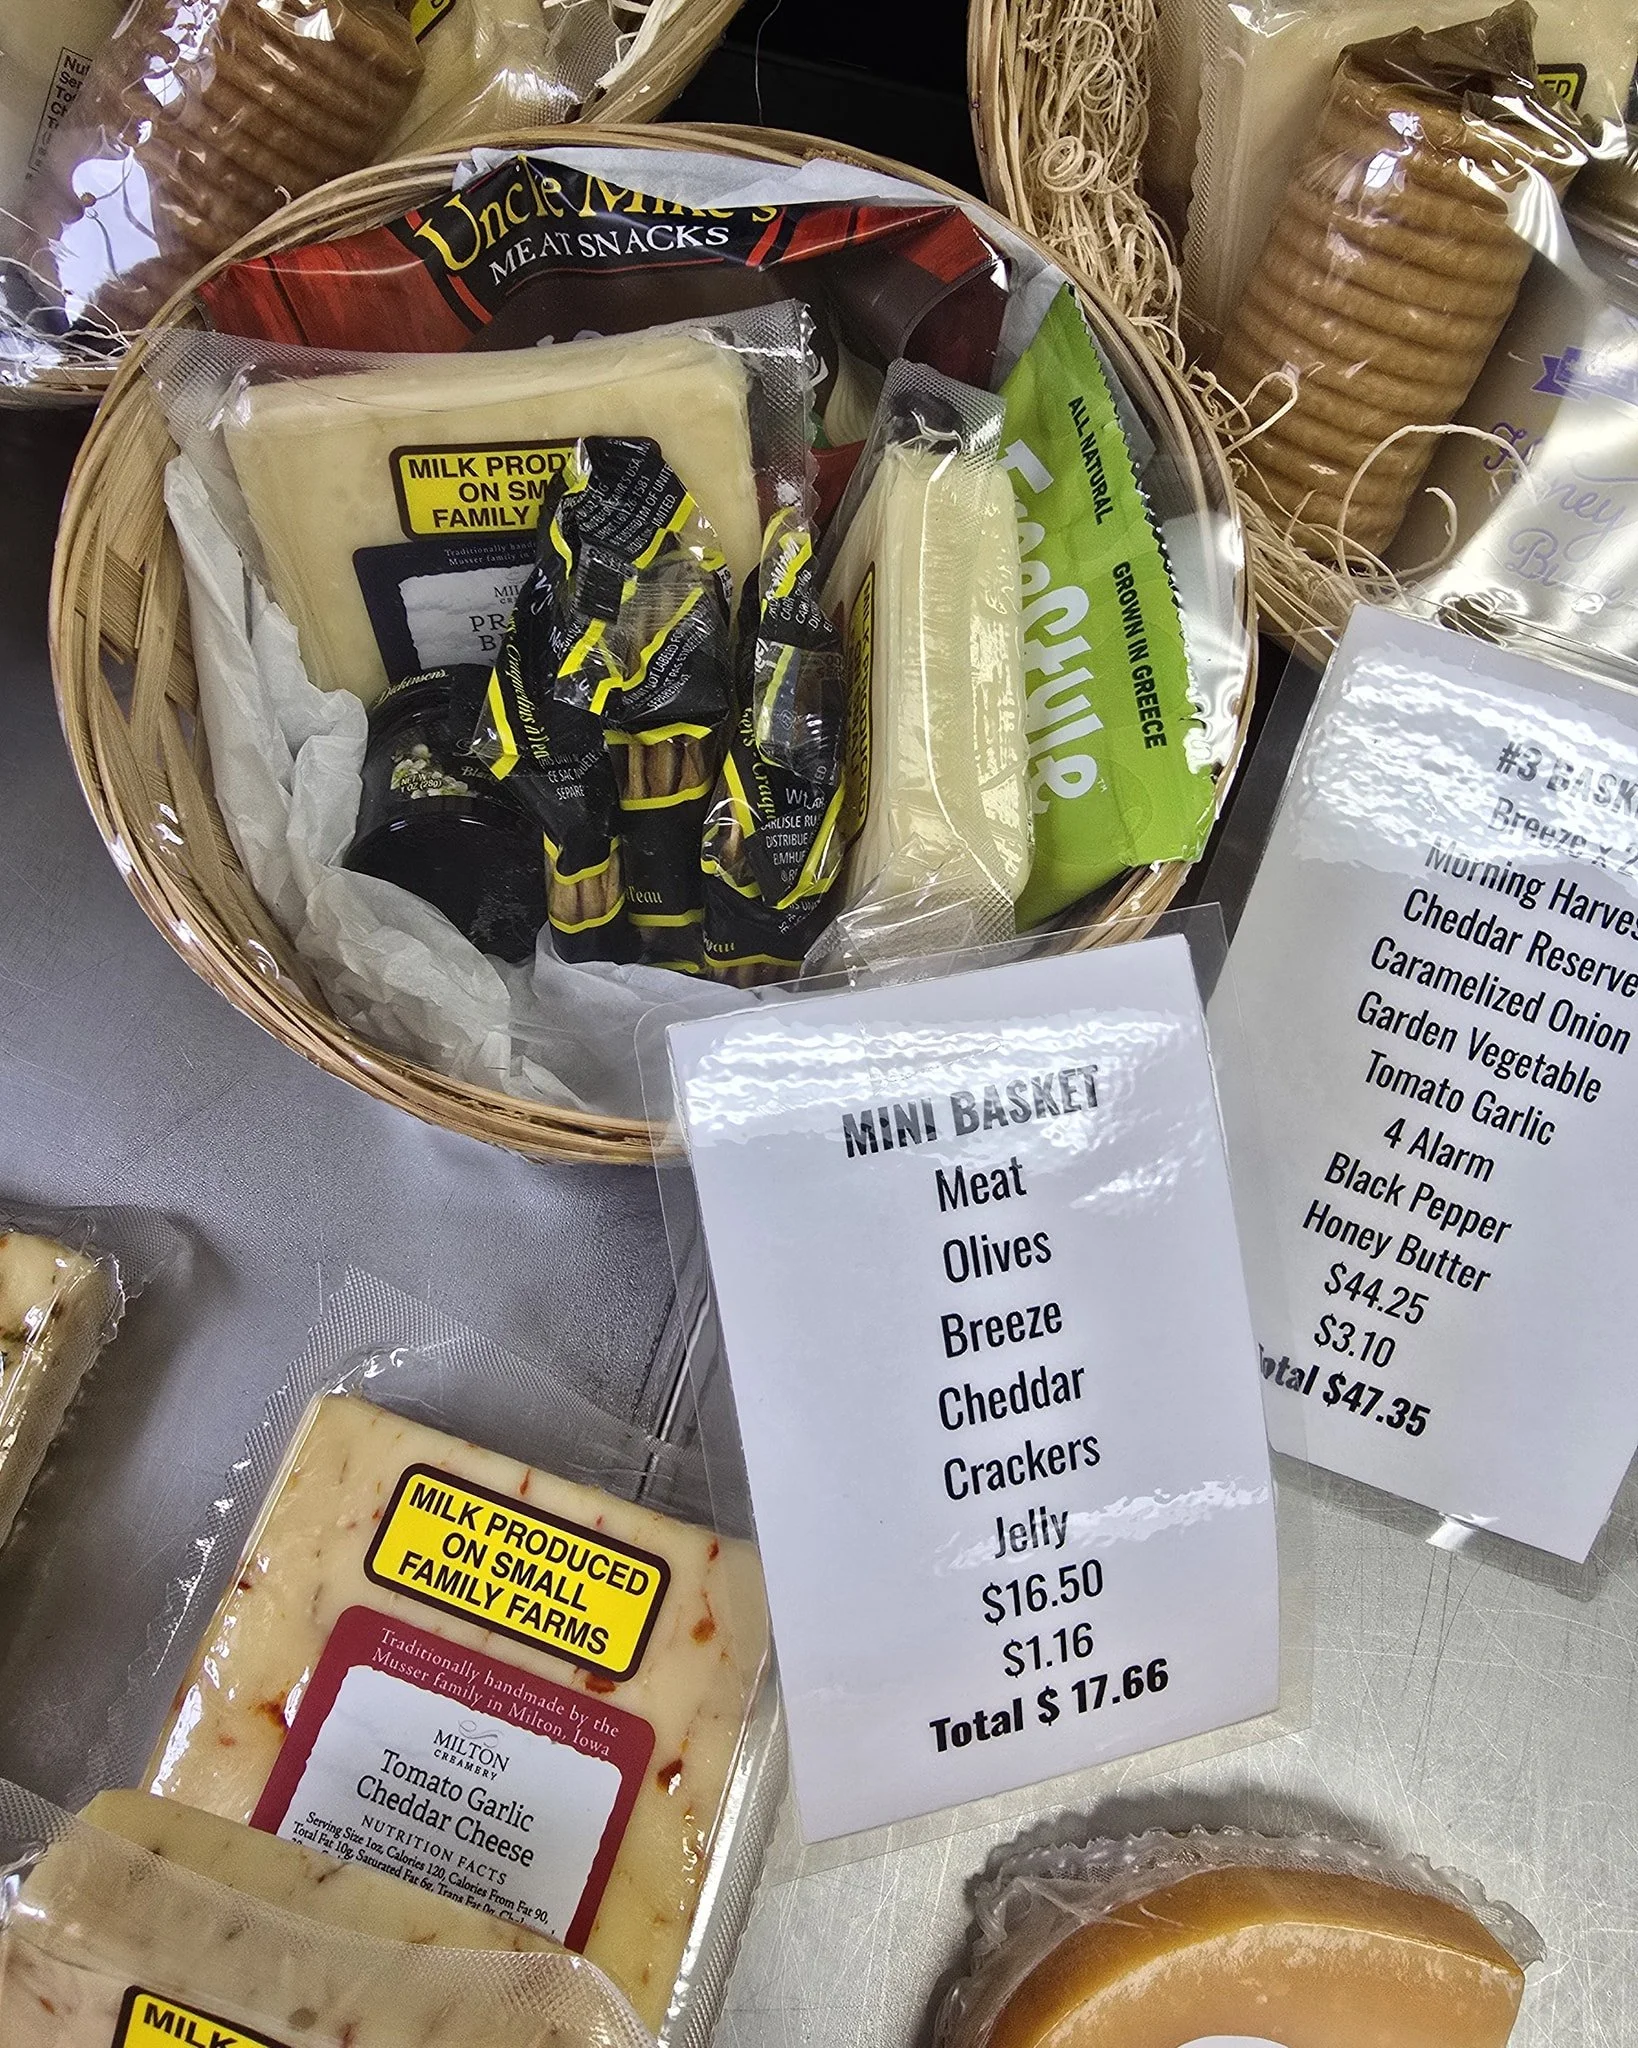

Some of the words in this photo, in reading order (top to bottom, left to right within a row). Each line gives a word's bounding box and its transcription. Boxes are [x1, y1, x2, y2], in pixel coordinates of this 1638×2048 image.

[415, 156, 563, 271] Uncle
[488, 231, 574, 286] MEAT
[580, 224, 729, 259] SNACKS
[408, 457, 485, 479] MILK
[486, 452, 572, 477] PROD
[459, 482, 499, 503] ON
[1068, 396, 1088, 438] ALL
[1079, 433, 1115, 526] NATURAL
[432, 506, 530, 528] FAMILY
[652, 494, 678, 527] IMITED.
[1111, 561, 1145, 641] GROWN
[1126, 635, 1149, 664] IN
[1132, 656, 1167, 750] GREECE
[1496, 741, 1543, 782] #3
[1546, 757, 1638, 820] BASK
[1488, 796, 1588, 859] Breeze
[1424, 834, 1547, 910] Morning
[1403, 888, 1523, 956] Cheddar
[1525, 930, 1638, 999] Reserve
[1371, 936, 1547, 1024] Caramelized
[1548, 999, 1632, 1056] Onion
[1357, 991, 1459, 1053] Garden
[1467, 1027, 1603, 1103] Vegetable
[842, 1097, 938, 1158] MINI
[951, 1064, 1100, 1137] BASKET
[1365, 1050, 1465, 1114] Tomato
[1471, 1089, 1557, 1146] Garlic
[935, 1156, 1028, 1212] Meat
[1383, 1117, 1406, 1150] 4
[1407, 1126, 1496, 1183] Alarm
[1323, 1151, 1406, 1207] Black
[1408, 1182, 1512, 1245] Pepper
[942, 1231, 1053, 1283] Olives
[1302, 1199, 1393, 1260] Honey
[1395, 1233, 1492, 1293] Butter
[940, 1301, 1064, 1358] Breeze
[1323, 1261, 1430, 1325] $44.25
[1314, 1312, 1396, 1369] $3.10
[938, 1365, 1086, 1431] Cheddar
[1322, 1371, 1431, 1437] $47.35
[943, 1435, 1102, 1500] Crackers
[409, 1483, 484, 1531] MILK
[485, 1512, 650, 1596] PRODUCED
[994, 1506, 1069, 1559] Jelly
[398, 1551, 504, 1610] FAMILY
[506, 1595, 610, 1655] FARMS
[442, 1533, 488, 1568] ON
[490, 1551, 588, 1612] SMALL
[981, 1559, 1104, 1626] $16.50
[382, 1627, 481, 1684] Traditionally
[484, 1670, 565, 1715] handmade
[569, 1704, 589, 1728] by
[593, 1714, 620, 1738] the
[1002, 1622, 1095, 1679] $1.16
[371, 1647, 429, 1682] Musser
[432, 1671, 483, 1708] family
[487, 1695, 502, 1712] in
[507, 1702, 567, 1740] Milton,
[573, 1729, 610, 1756] Iowa
[929, 1697, 1025, 1753] Total
[1037, 1685, 1061, 1727] $
[1071, 1658, 1170, 1714] 17.66
[433, 1729, 510, 1772] MILTON
[433, 1749, 498, 1781] CREAMERY
[356, 1775, 451, 1832] Cheddar
[455, 1816, 534, 1867] Cheese
[380, 1748, 463, 1801] Tomato
[467, 1788, 535, 1832] Garlic
[292, 1821, 318, 1841] Total
[318, 1833, 333, 1849] Fat
[335, 1841, 354, 1860] 10g,
[355, 1849, 404, 1879] Saturated
[403, 1868, 418, 1885] Fat
[437, 1882, 464, 1904] Trans
[306, 1811, 342, 1839] Serving
[343, 1826, 364, 1844] Size
[365, 1837, 384, 1855] 1oz,
[386, 1845, 425, 1871] Calories
[426, 1863, 446, 1882] 120,
[449, 1872, 488, 1898] Calories
[489, 1888, 515, 1910] From
[517, 1900, 533, 1917] Fat
[535, 1908, 549, 1924] 90,
[361, 1815, 455, 1862] NUTRITION
[457, 1855, 507, 1885] FACTS
[143, 2002, 238, 2048] MILK
